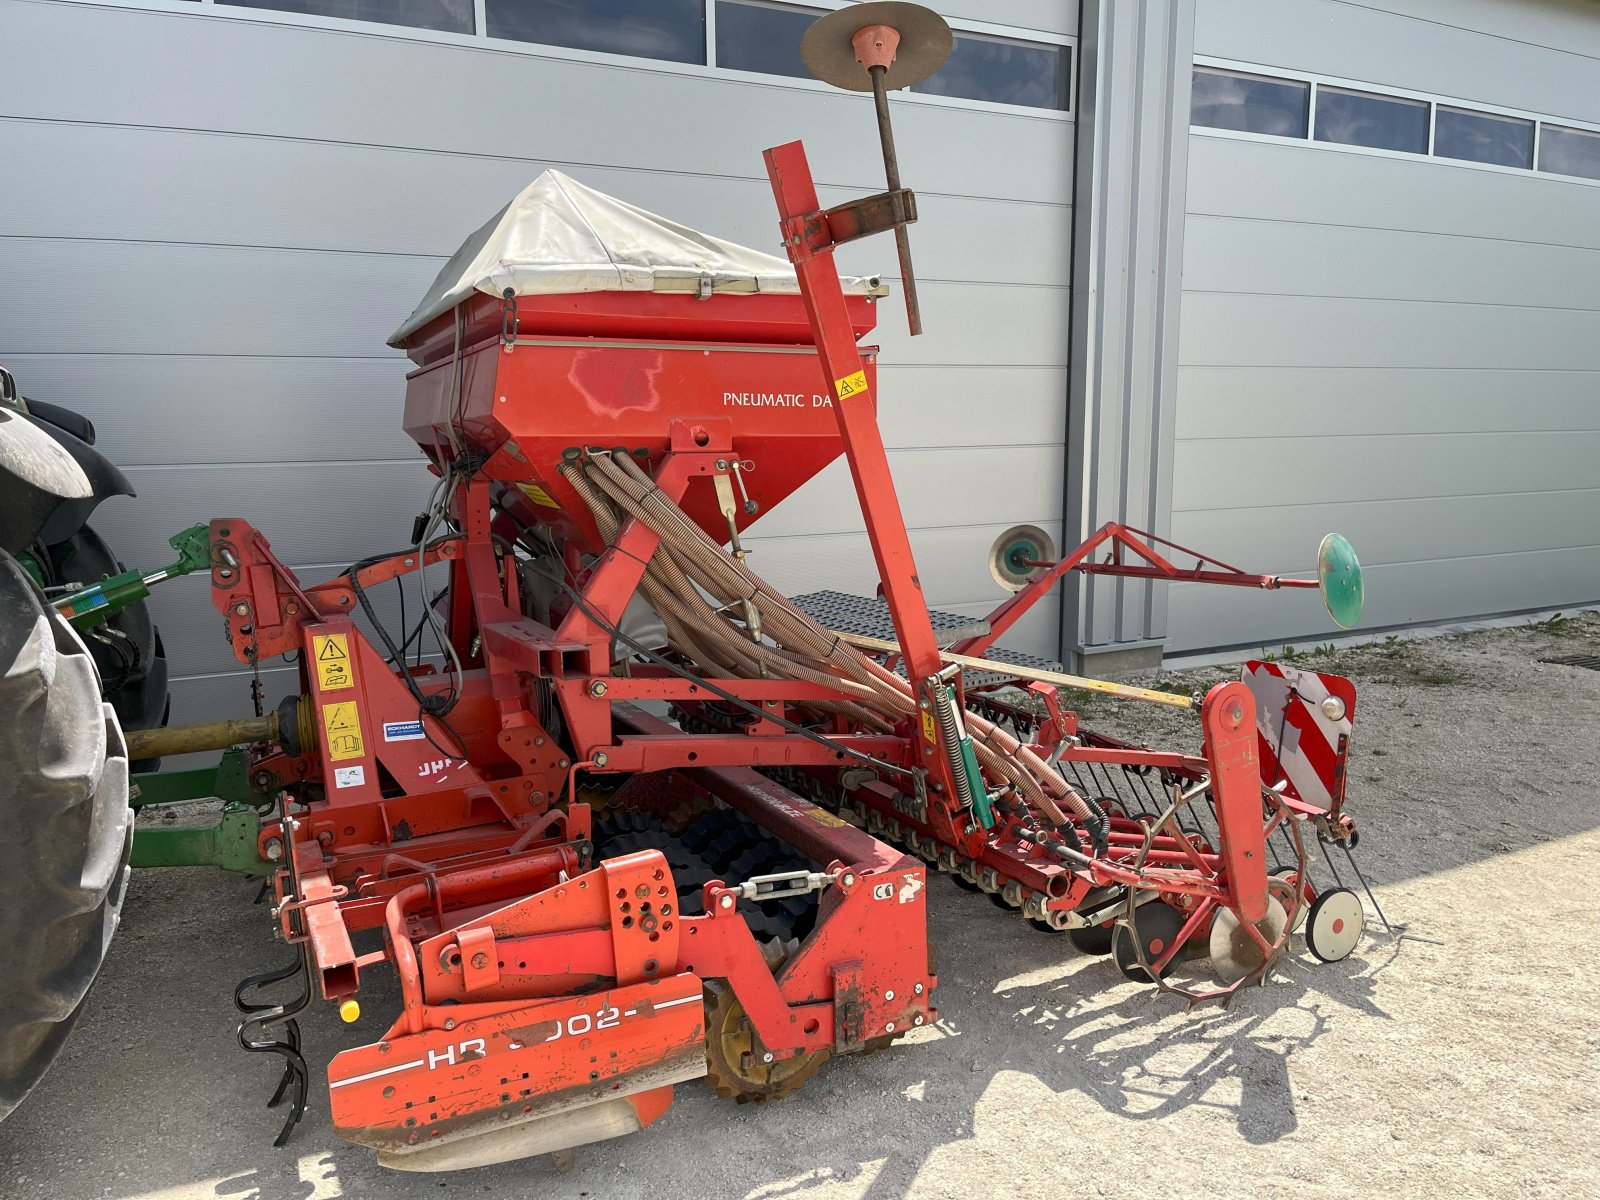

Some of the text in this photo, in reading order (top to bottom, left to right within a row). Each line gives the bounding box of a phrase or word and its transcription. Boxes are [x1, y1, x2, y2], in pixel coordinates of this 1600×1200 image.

[723, 392, 805, 407] PNEUMATIC
[387, 724, 421, 732] ECKHARDT
[428, 1038, 487, 1070] HR
